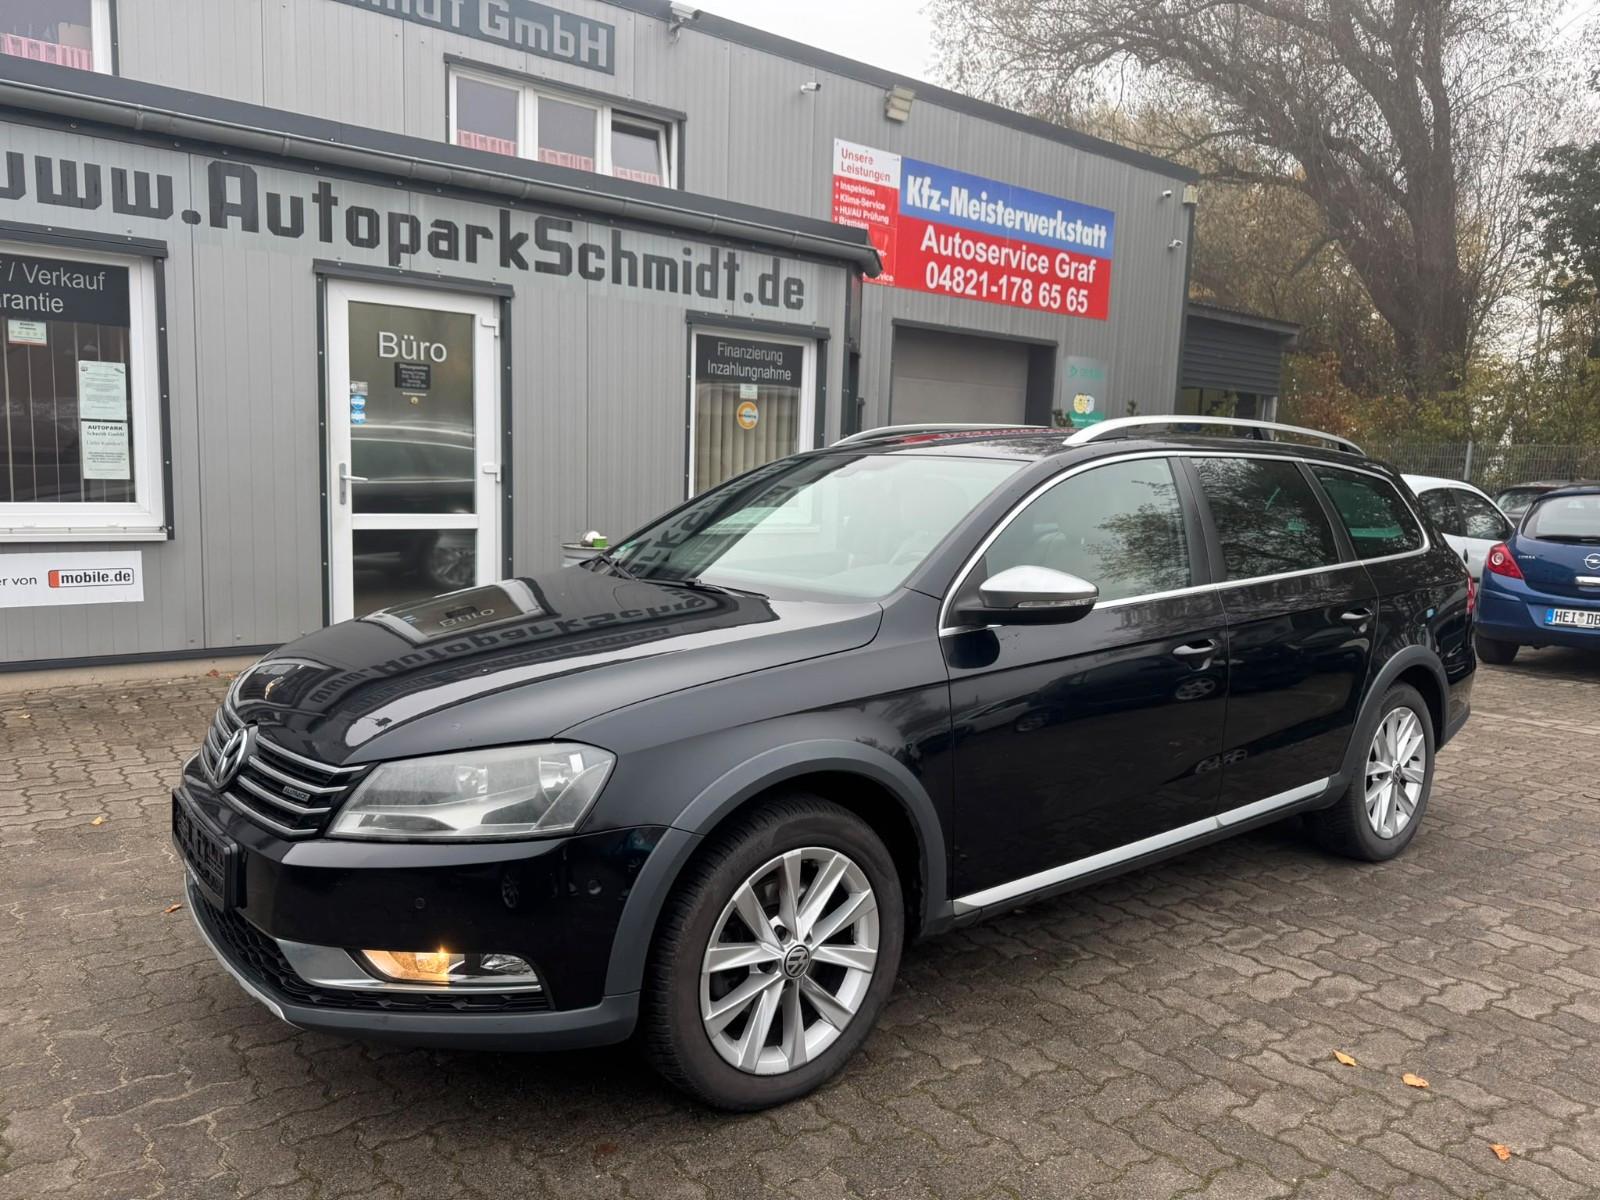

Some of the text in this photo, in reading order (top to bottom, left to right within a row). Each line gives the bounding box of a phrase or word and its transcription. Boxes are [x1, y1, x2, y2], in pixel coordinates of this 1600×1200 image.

[478, 0, 608, 68] GmbH
[841, 147, 875, 165] Unsere
[841, 161, 891, 183] Leistungen
[840, 181, 876, 196] Inspektion
[906, 175, 1107, 249] Kfz-Meisterwerkstatt
[920, 224, 1097, 284] Autoservice Graf
[22, 263, 106, 292] Verkauf
[925, 261, 1089, 314] 04821-178 65 65
[0, 291, 64, 313] rantie
[378, 331, 448, 363] Büro
[717, 341, 783, 366] Finanzierung
[707, 360, 792, 381] Inzahlungnahme
[11, 576, 38, 586] von
[61, 570, 131, 584] mobile.de
[1555, 610, 1577, 624] HEI
